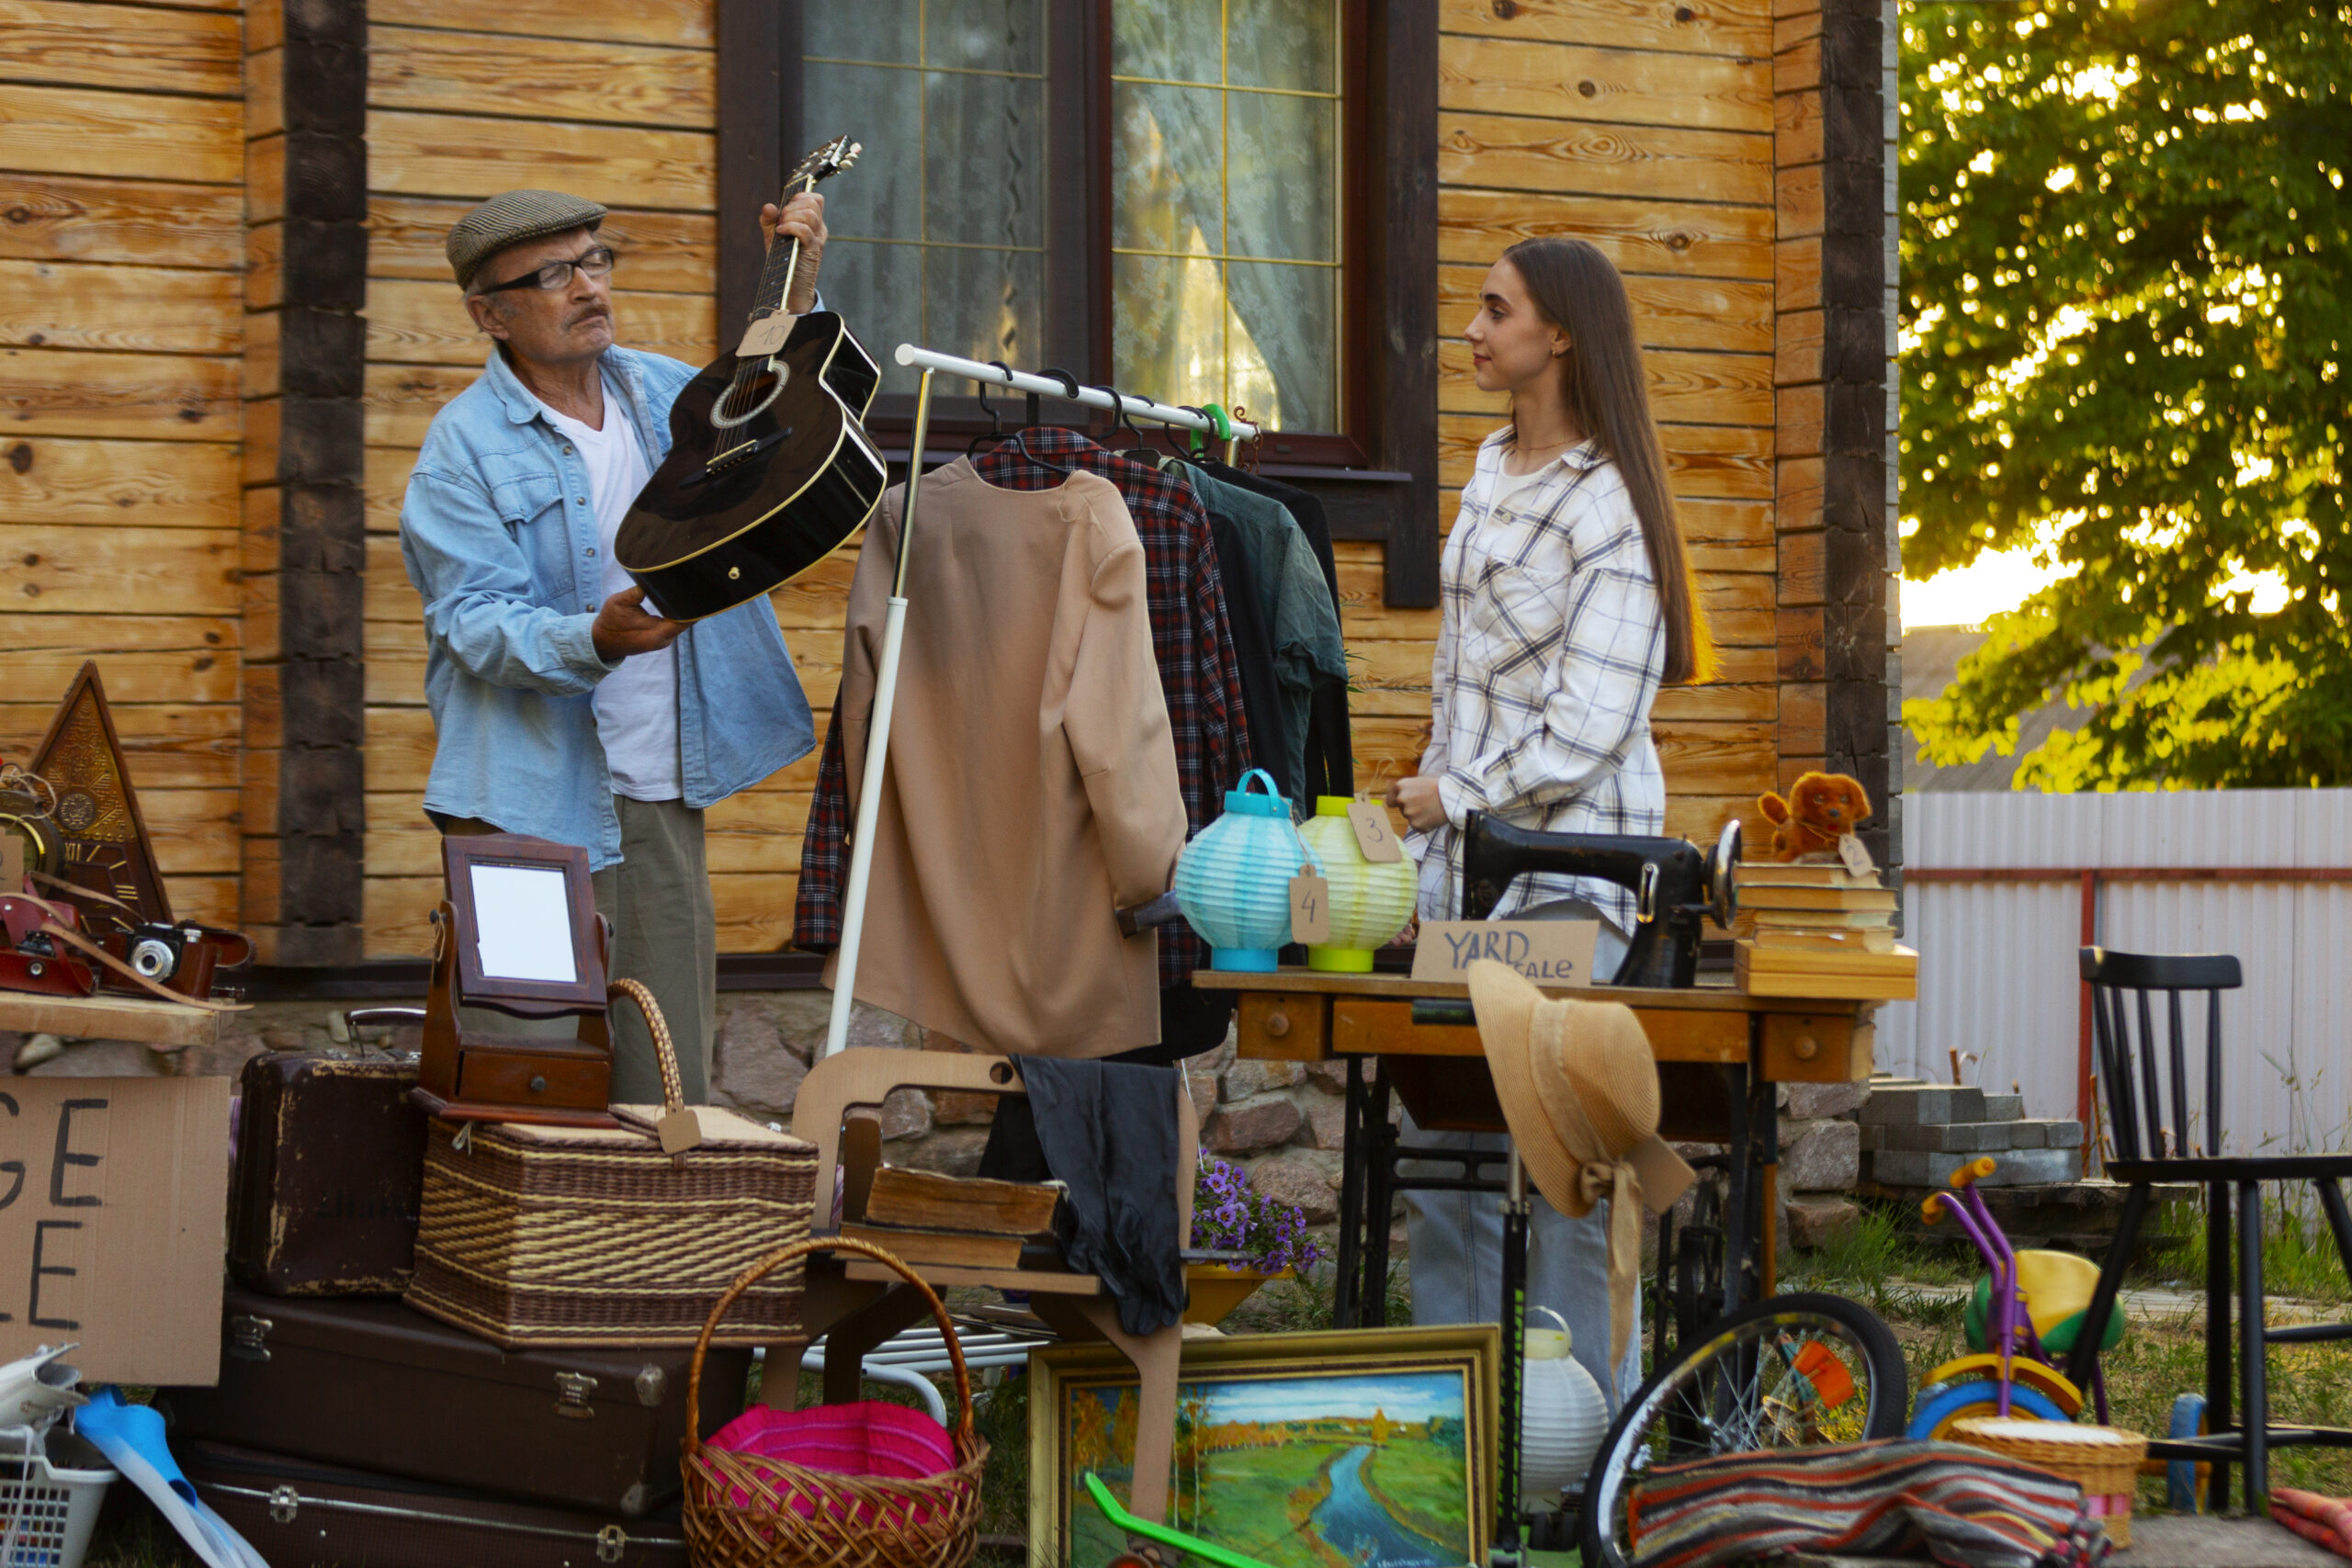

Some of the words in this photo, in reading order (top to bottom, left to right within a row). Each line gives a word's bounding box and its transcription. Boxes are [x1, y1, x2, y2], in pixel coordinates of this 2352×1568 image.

[758, 324, 786, 345] 10
[1365, 818, 1384, 843] 3
[1846, 845, 1864, 866] 2
[1301, 889, 1316, 924] 4
[1444, 930, 1530, 969] YARD
